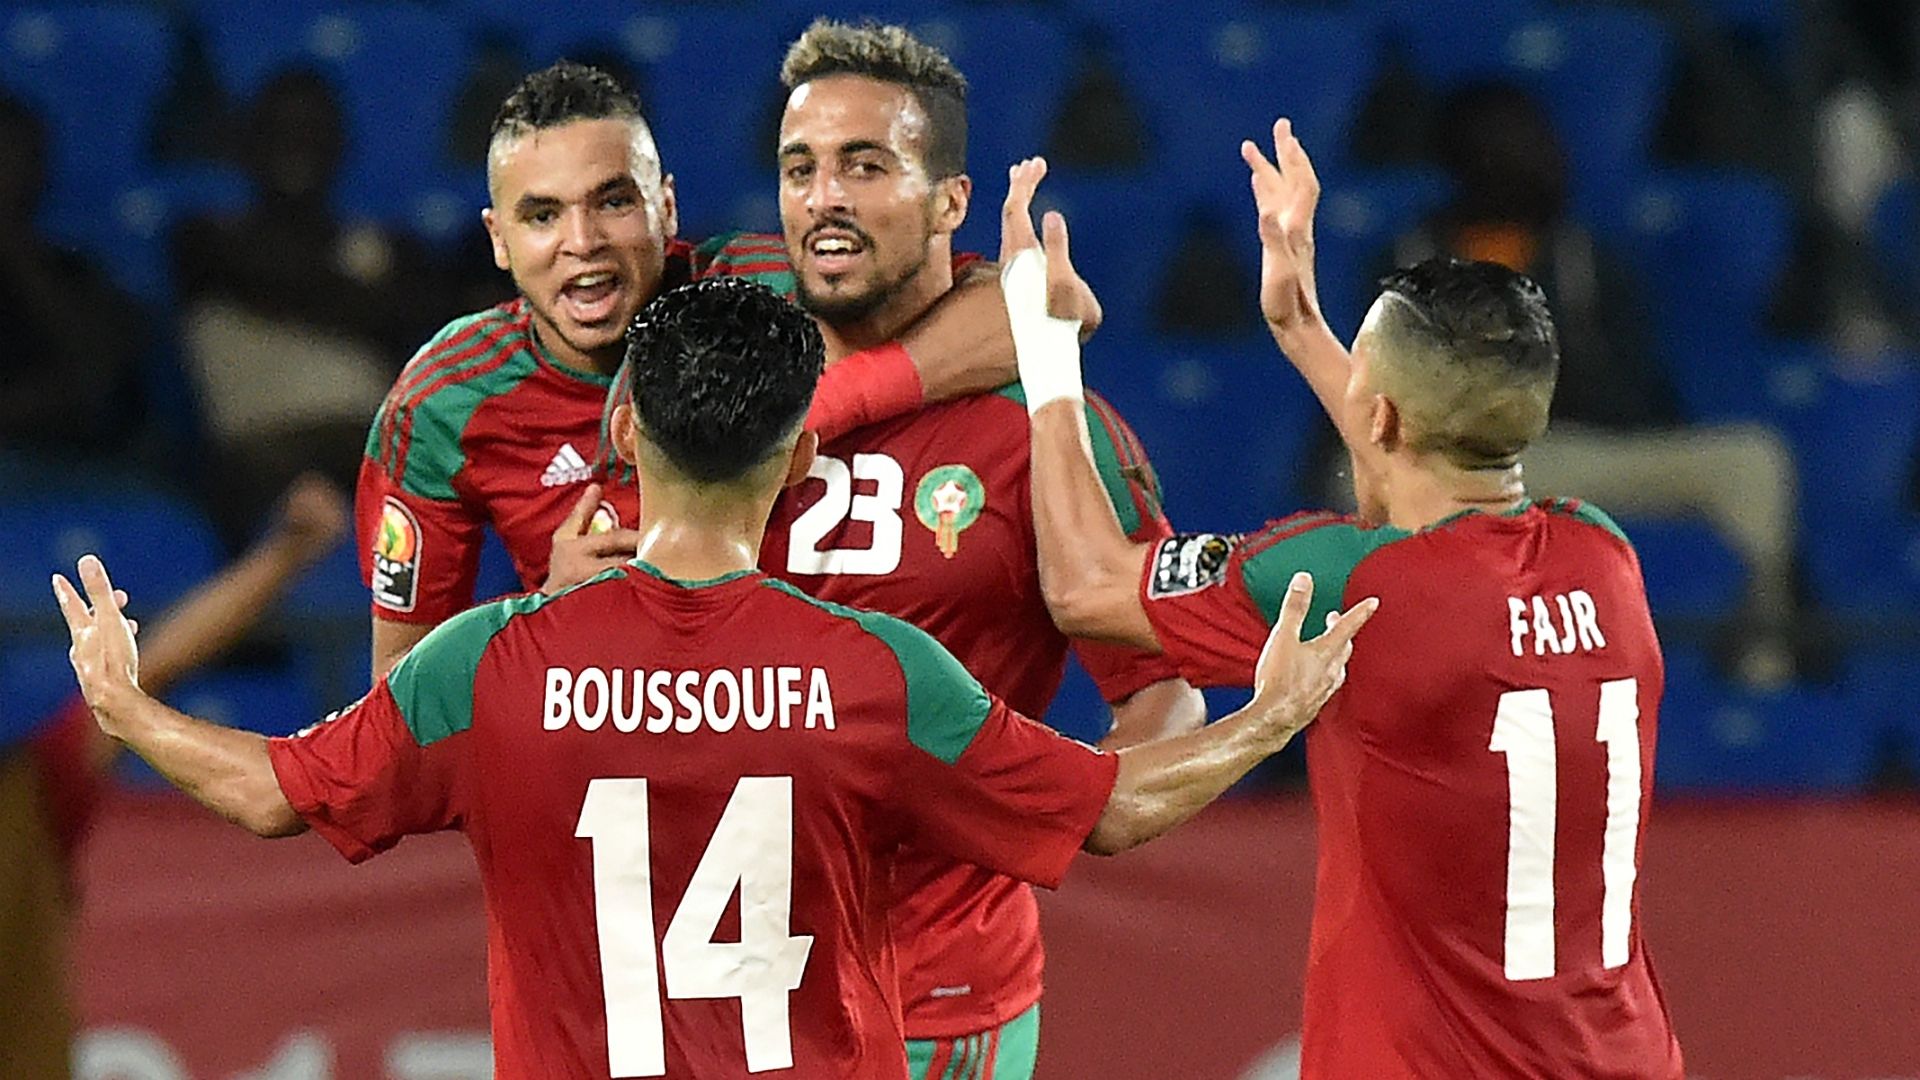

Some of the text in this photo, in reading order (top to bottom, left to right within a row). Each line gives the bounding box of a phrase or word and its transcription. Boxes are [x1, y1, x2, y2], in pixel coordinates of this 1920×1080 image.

[787, 453, 904, 575] 23
[1508, 590, 1606, 657] FAJR
[544, 667, 835, 734] BOUSSOUFA
[1489, 678, 1642, 981] 11
[575, 777, 815, 1079] 14
